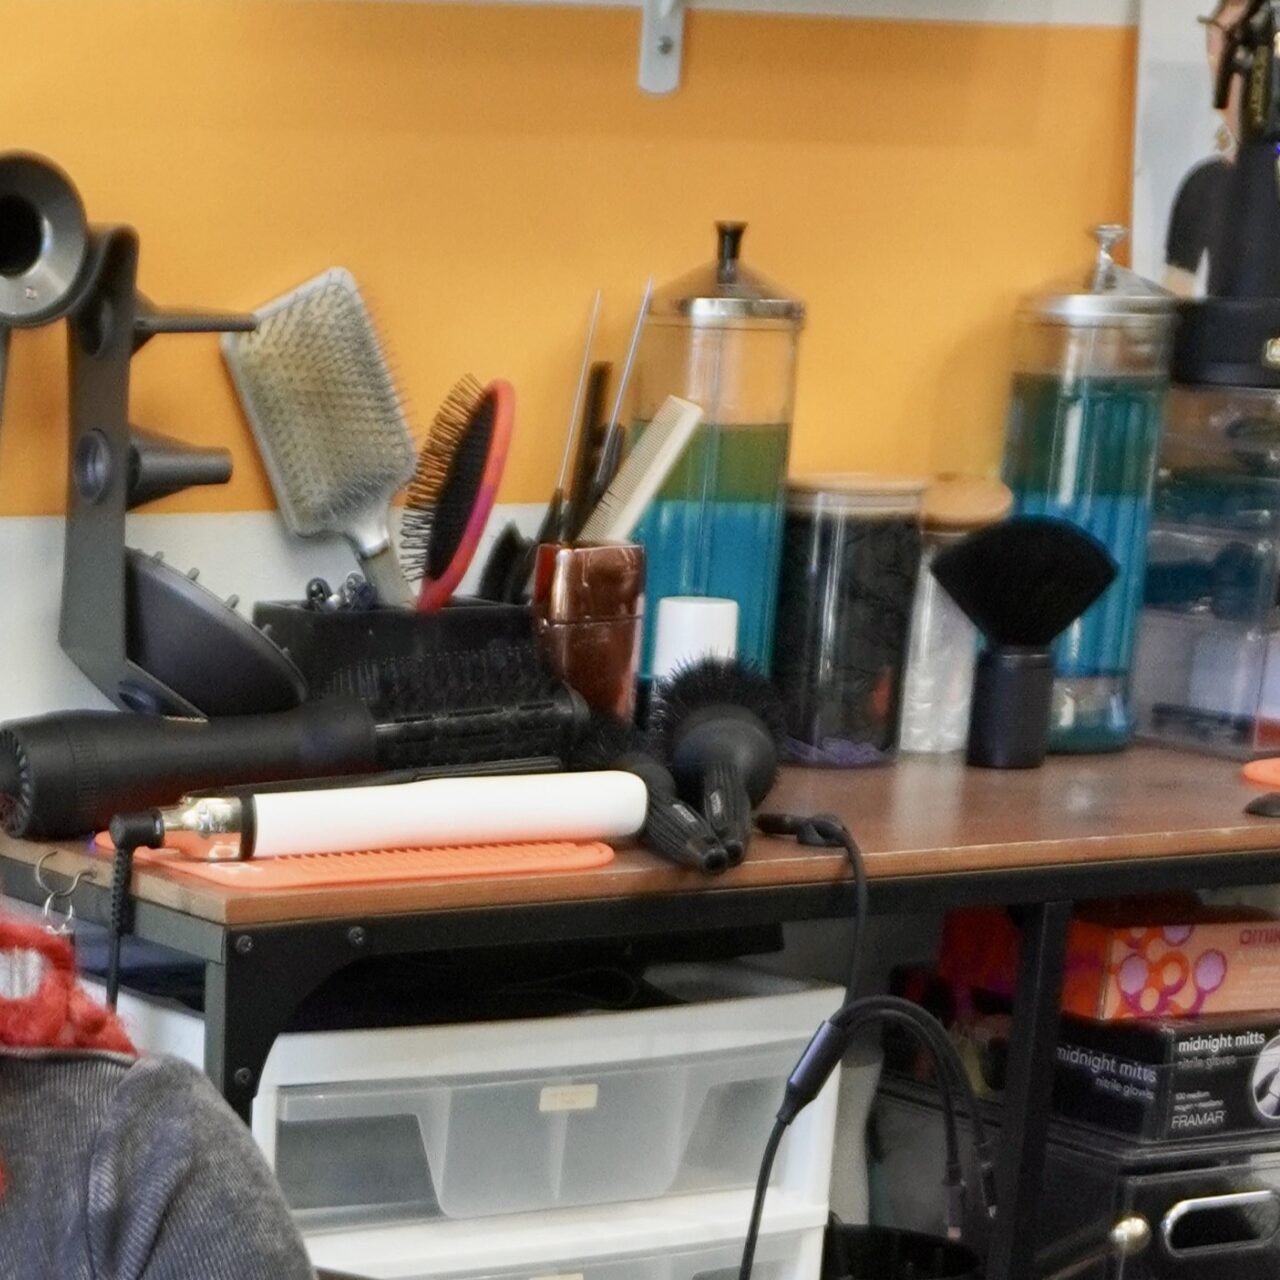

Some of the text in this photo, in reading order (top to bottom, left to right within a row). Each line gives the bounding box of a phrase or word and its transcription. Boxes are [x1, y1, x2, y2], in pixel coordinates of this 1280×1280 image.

[1178, 1031, 1265, 1053] midnight mitts
[1057, 1044, 1158, 1083] midnight mitts
[1171, 1110, 1225, 1129] FRAMAR
